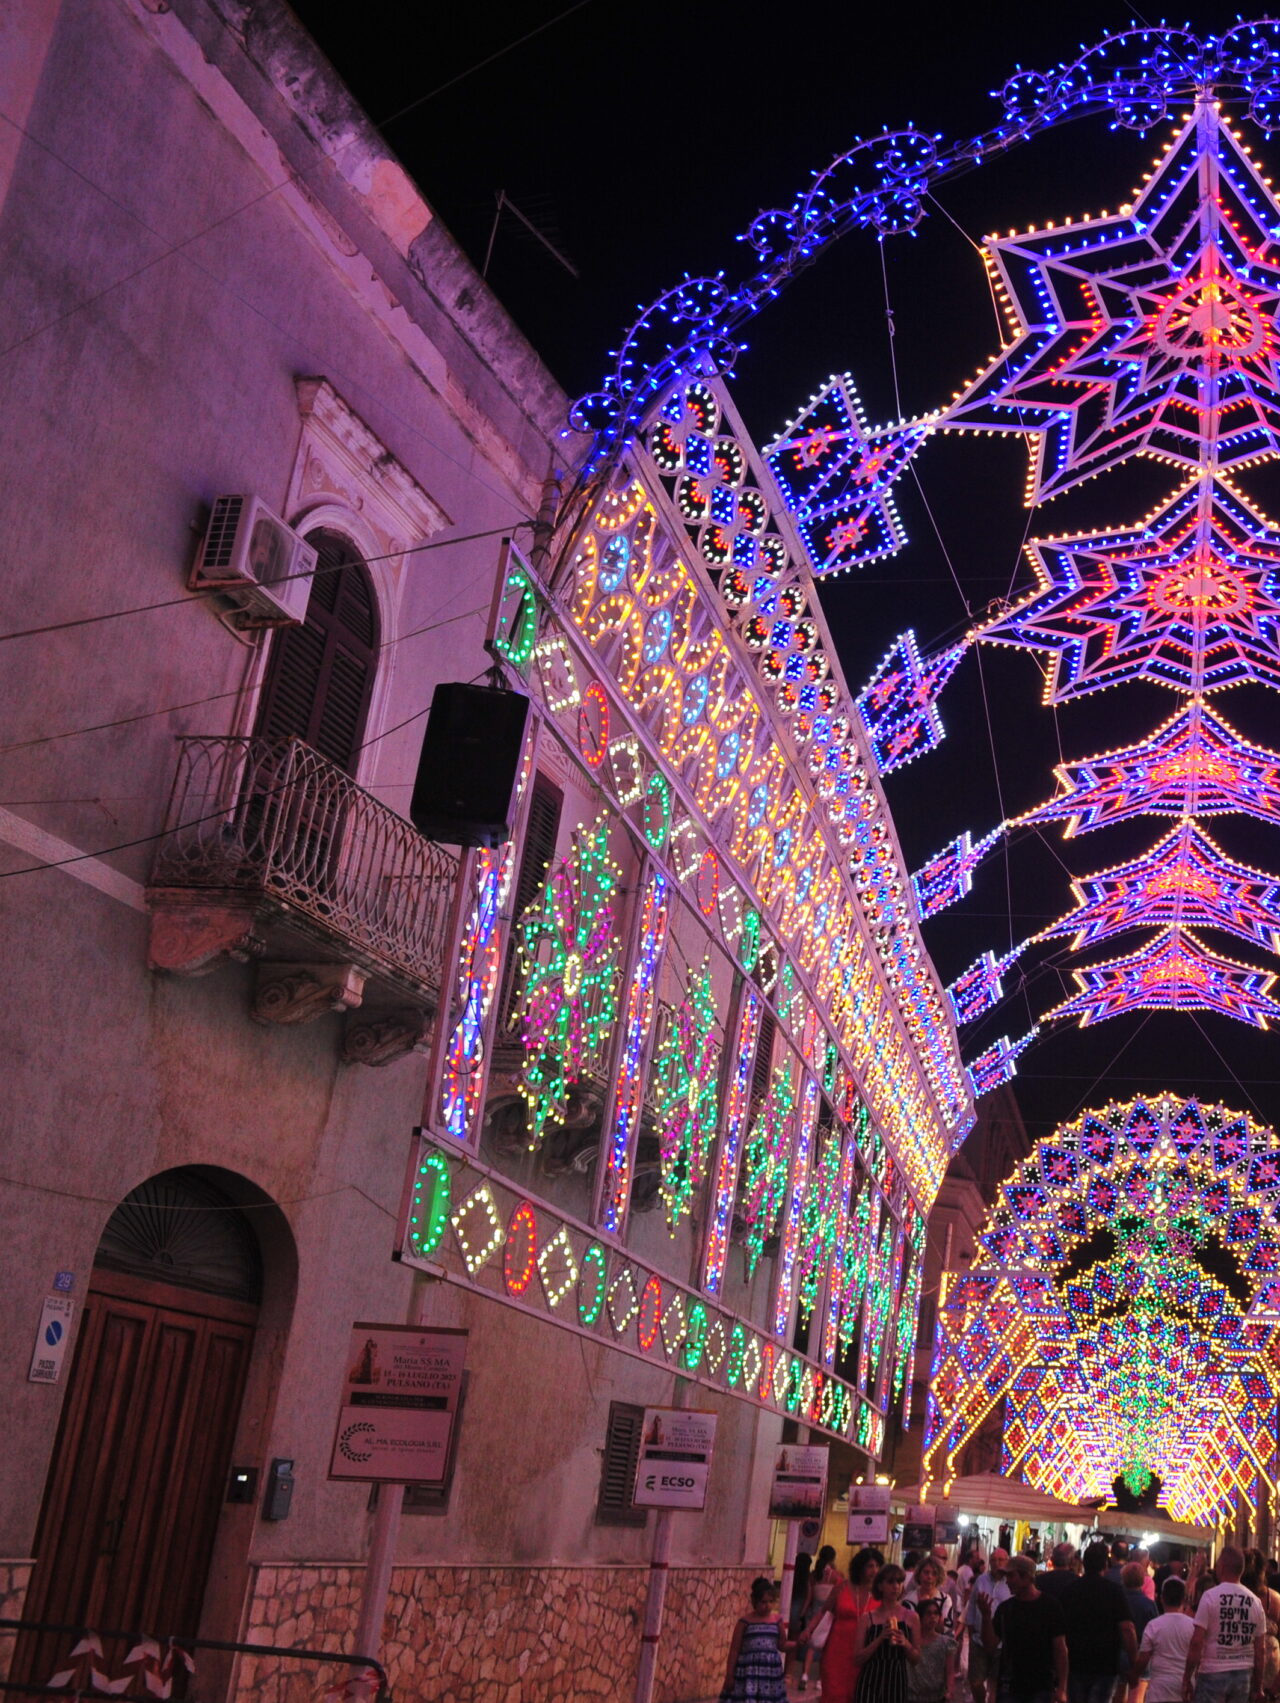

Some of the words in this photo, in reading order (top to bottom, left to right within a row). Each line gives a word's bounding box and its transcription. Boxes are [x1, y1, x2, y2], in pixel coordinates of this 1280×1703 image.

[57, 1273, 72, 1288] 29
[38, 1359, 56, 1370] PASSO
[393, 1355, 418, 1365] Maria
[406, 1370, 439, 1380] LUGLIO
[386, 1378, 431, 1389] PULSANO
[390, 1439, 425, 1447] ECOLOGIA
[660, 1475, 696, 1488] ECSO
